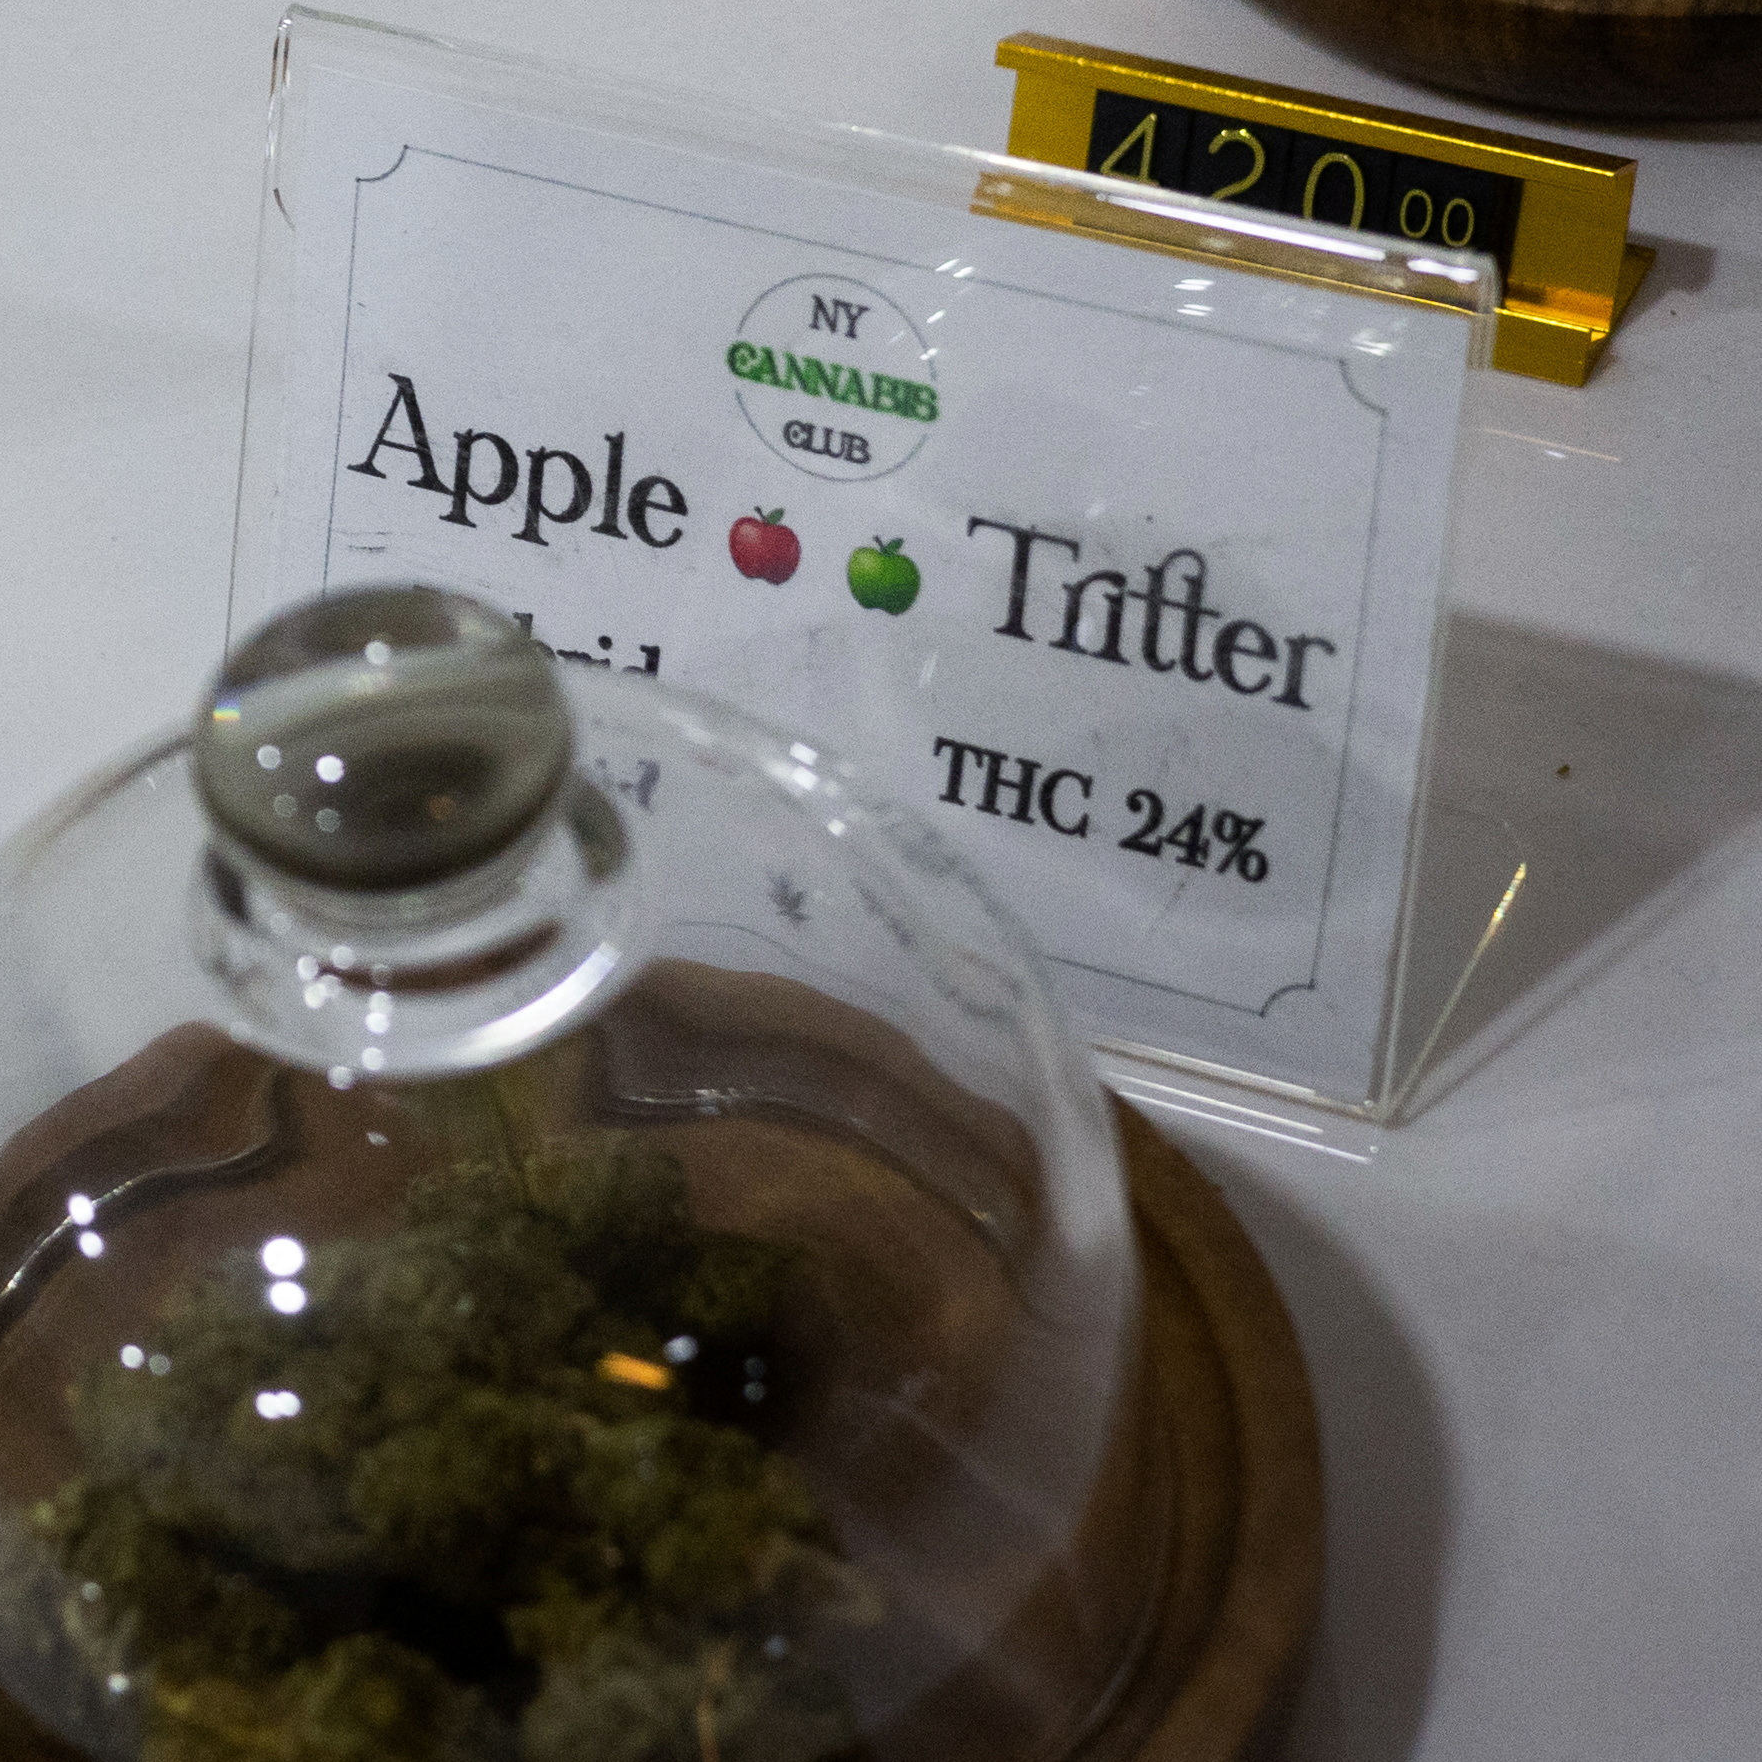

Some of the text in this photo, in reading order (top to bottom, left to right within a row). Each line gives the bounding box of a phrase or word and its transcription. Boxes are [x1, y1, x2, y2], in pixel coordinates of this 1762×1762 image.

[808, 293, 872, 339] NY
[725, 340, 941, 424] CANNABIS
[347, 372, 689, 549] Apple
[783, 419, 872, 465] CLUB
[933, 736, 1270, 884] THC 24%
